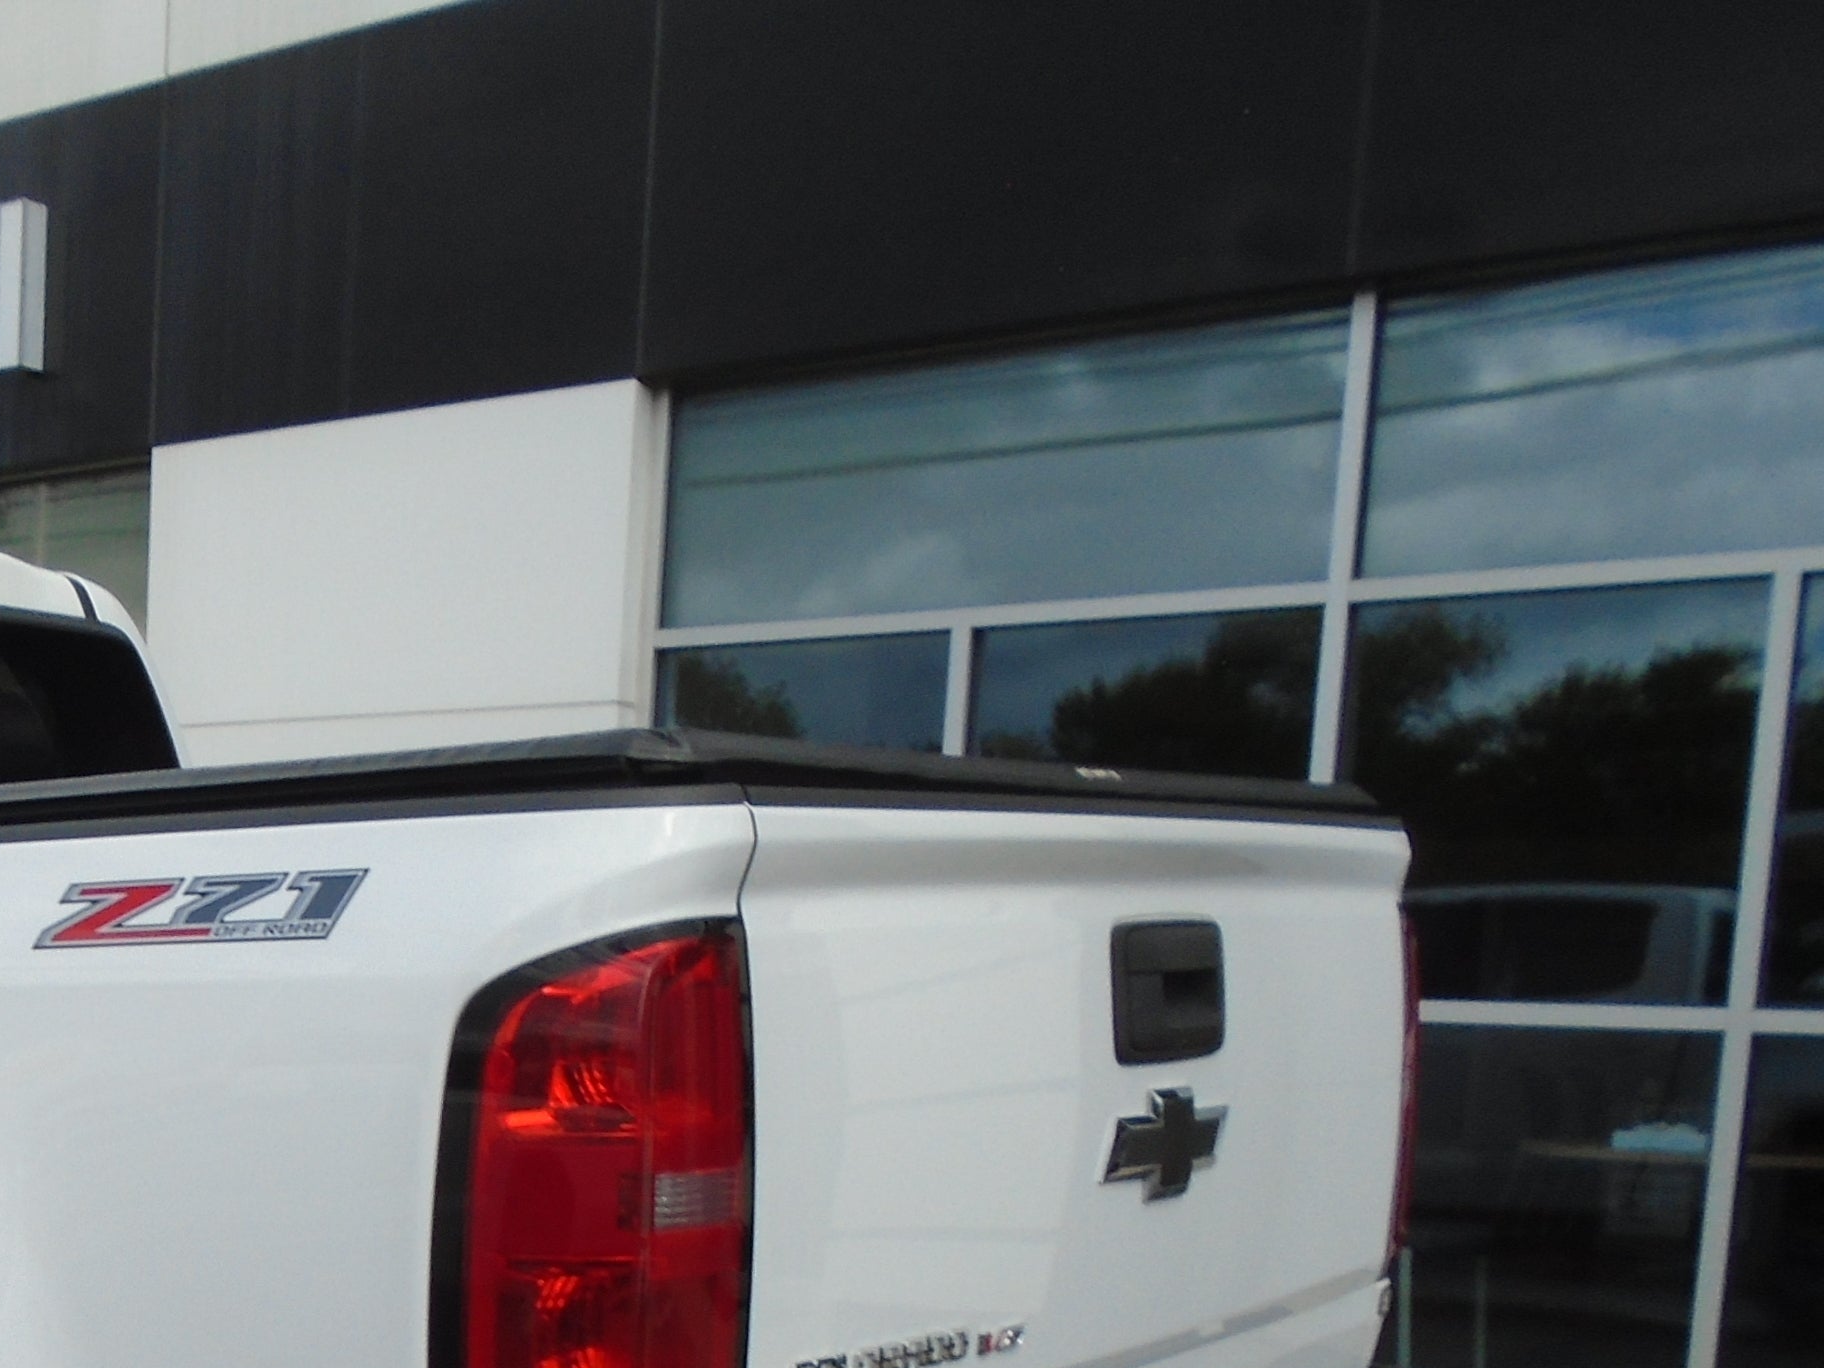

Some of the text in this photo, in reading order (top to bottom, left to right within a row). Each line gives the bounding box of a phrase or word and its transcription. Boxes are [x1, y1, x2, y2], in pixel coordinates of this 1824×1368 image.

[32, 867, 370, 949] Z71
[214, 922, 328, 937] OFF ROAD
